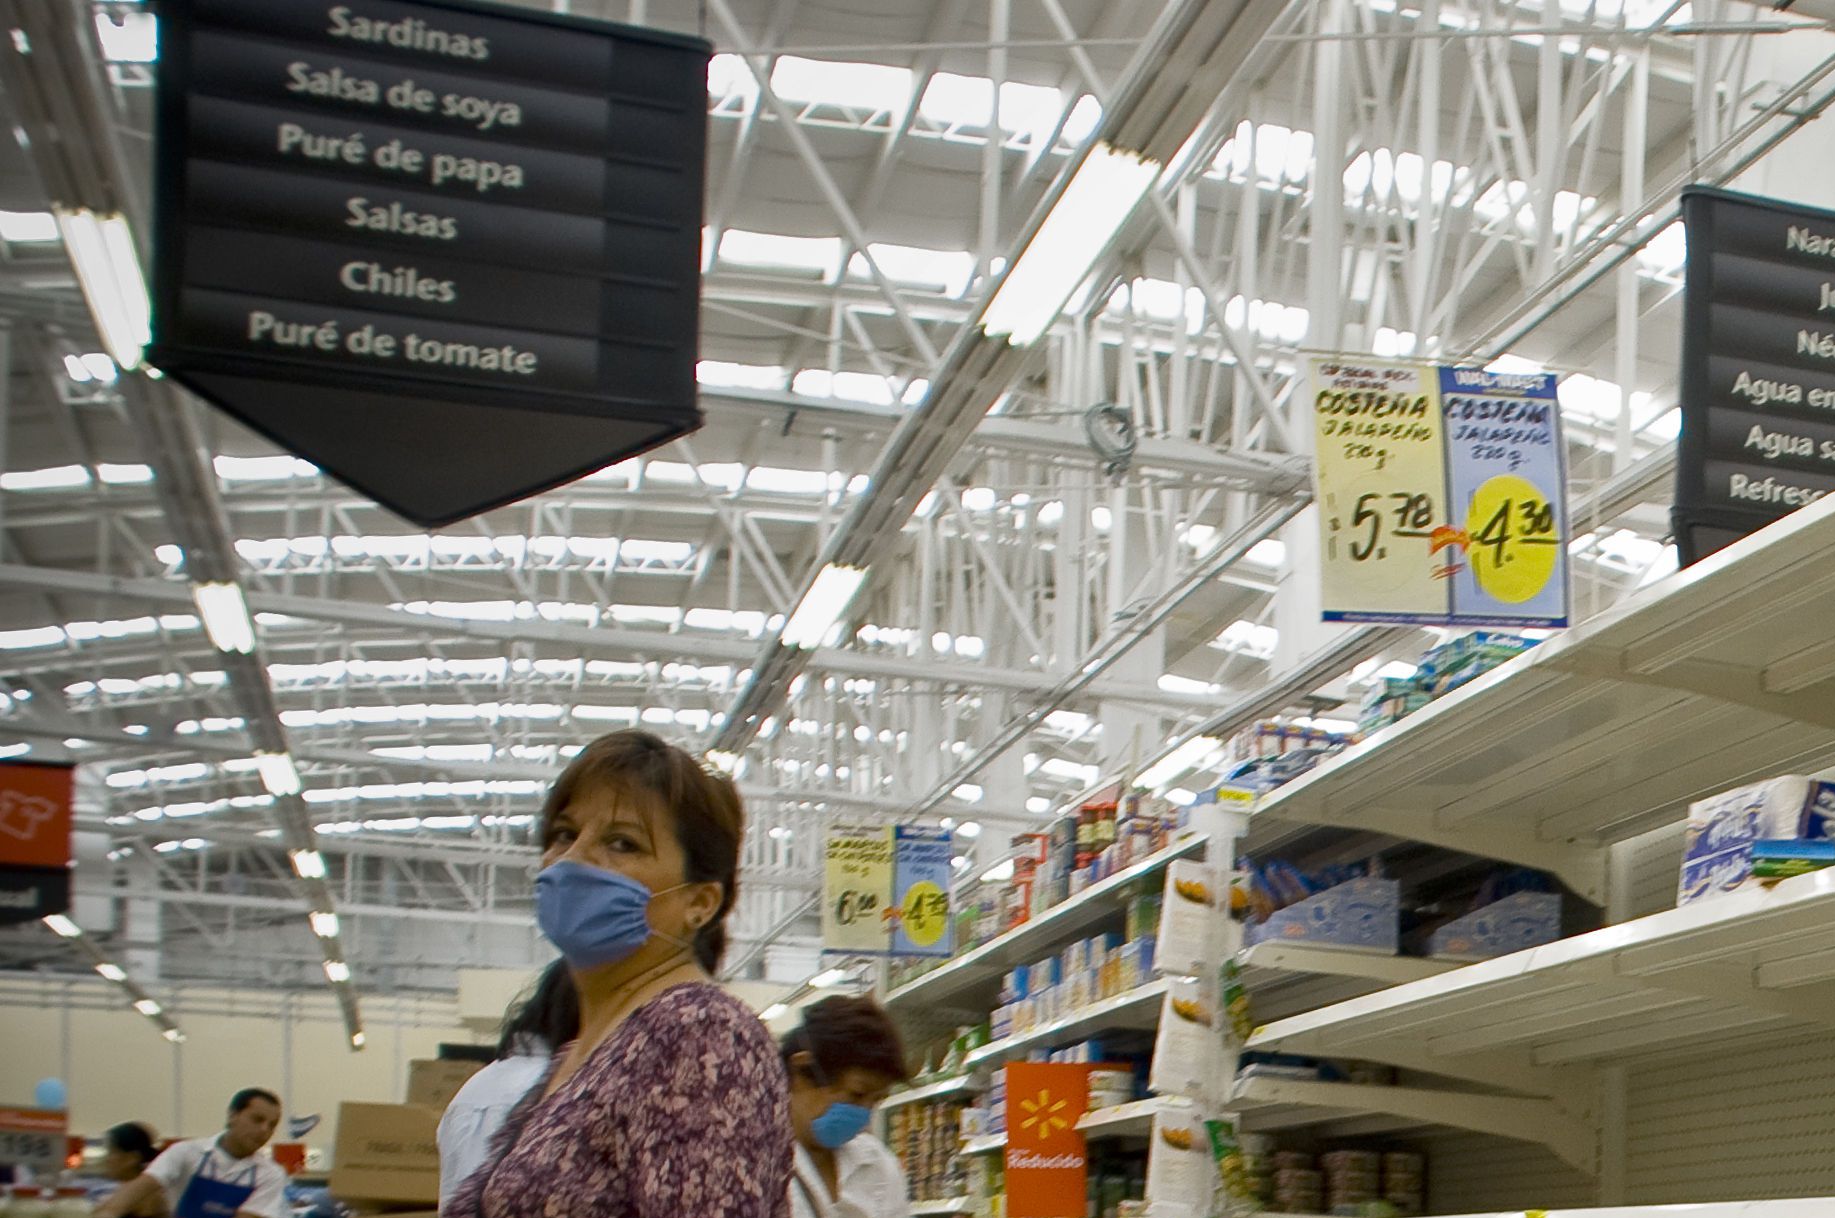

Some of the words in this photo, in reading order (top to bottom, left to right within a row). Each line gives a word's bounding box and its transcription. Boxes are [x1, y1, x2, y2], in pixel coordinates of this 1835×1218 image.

[327, 4, 490, 61] Sardinas
[286, 61, 380, 103] Salsa
[386, 78, 434, 112] de
[441, 90, 521, 130] soya
[277, 122, 368, 165] Puré
[374, 138, 423, 172] de
[431, 151, 524, 192] papa
[345, 197, 458, 240] Salsas
[340, 261, 456, 303] Chiles
[248, 310, 338, 353] Puré
[345, 324, 396, 358] de
[404, 333, 539, 376] tomate
[1730, 371, 1803, 407] Agua
[1744, 424, 1814, 459] Agua
[1007, 1153, 1085, 1169] Reducido
